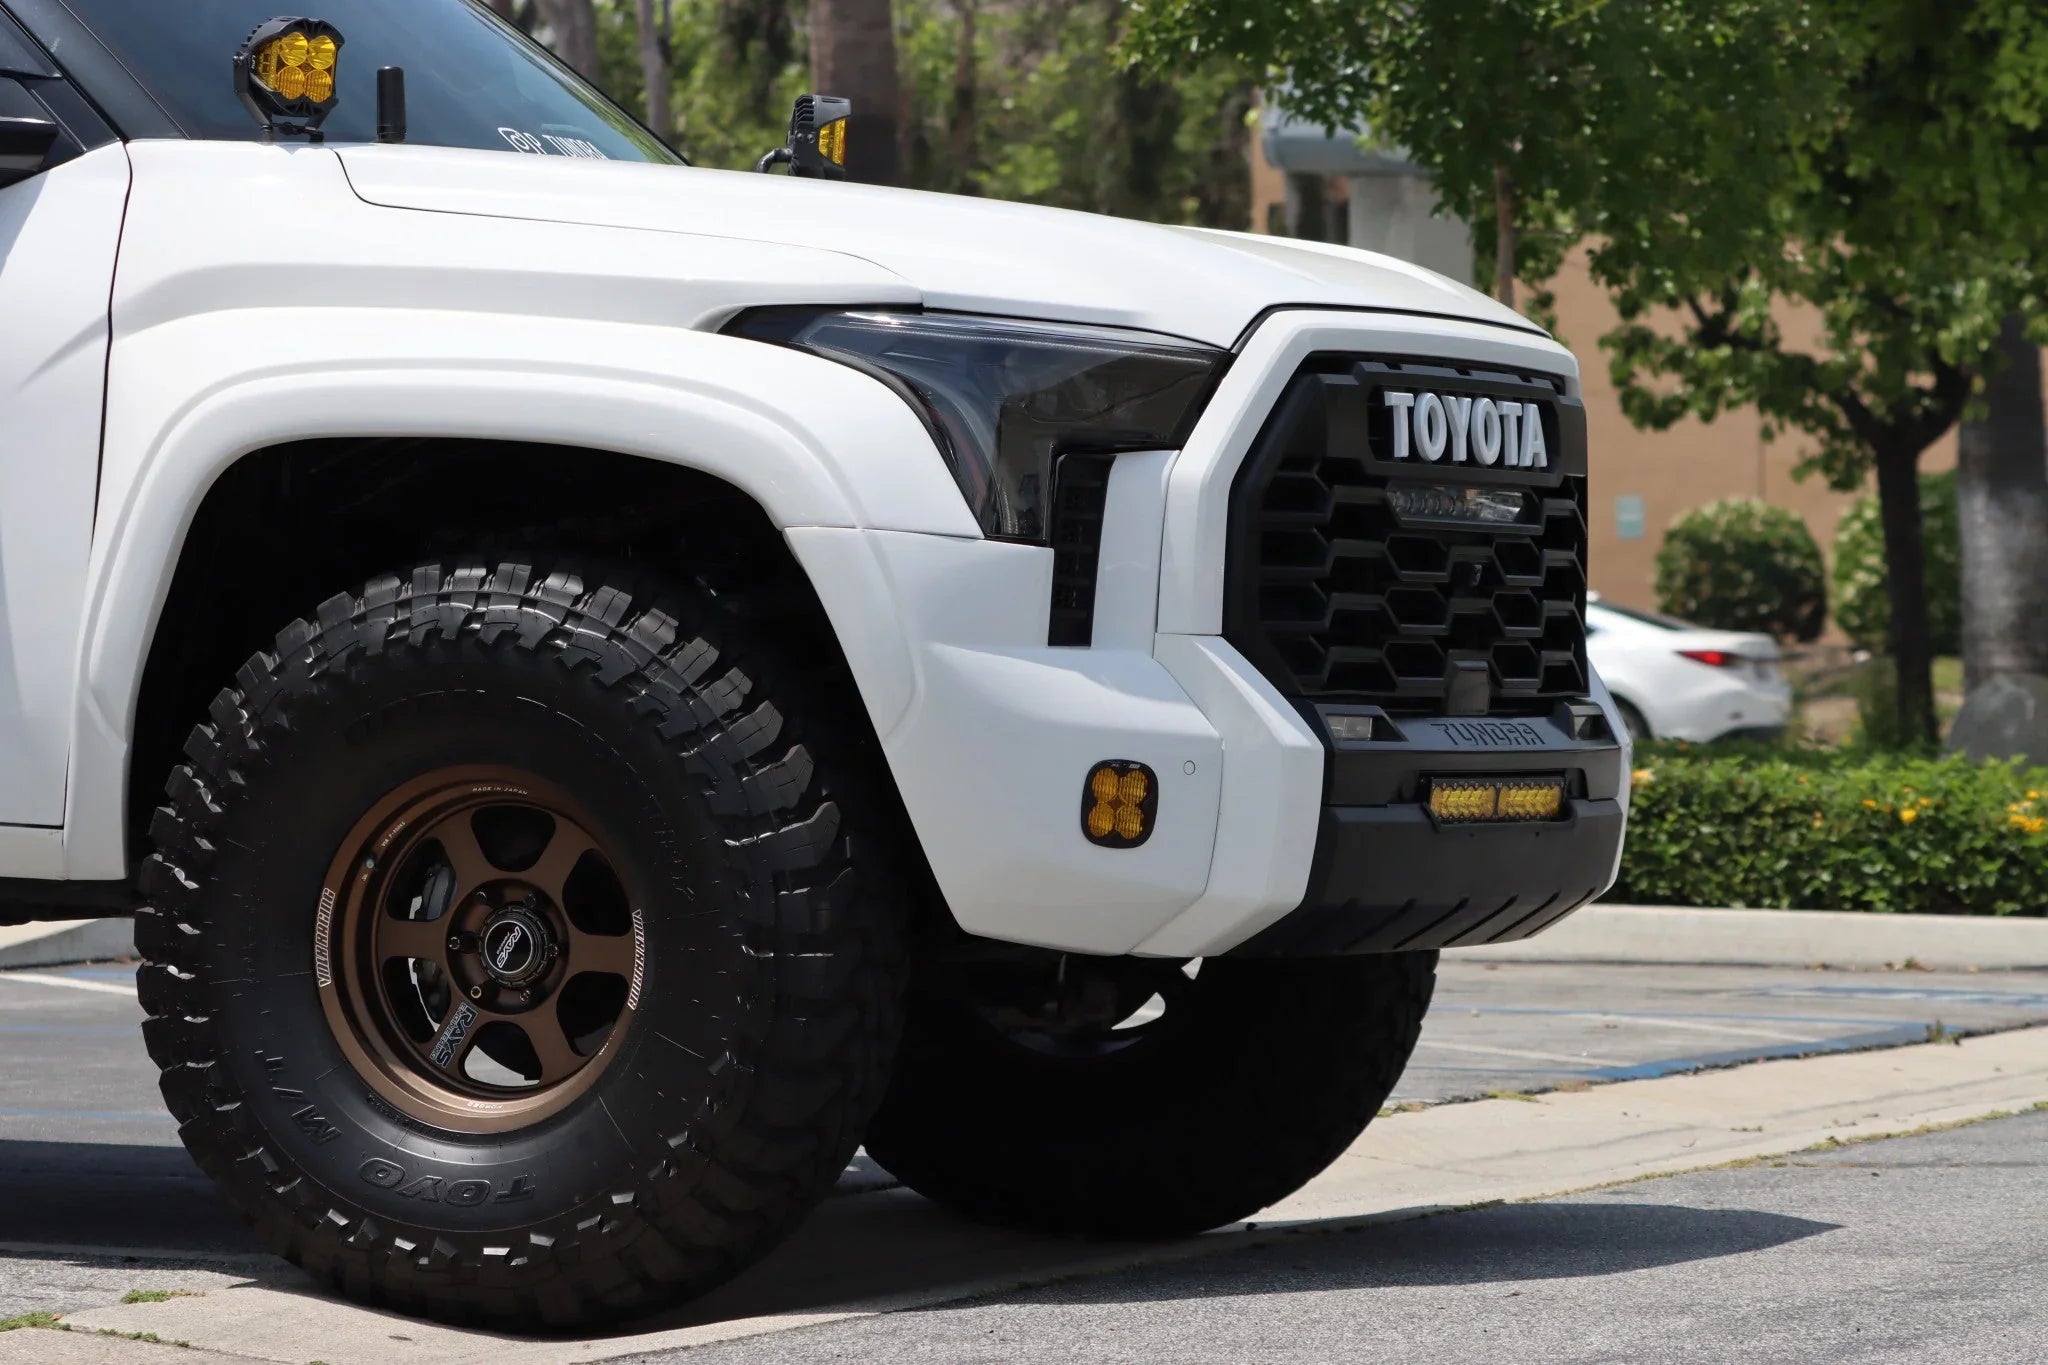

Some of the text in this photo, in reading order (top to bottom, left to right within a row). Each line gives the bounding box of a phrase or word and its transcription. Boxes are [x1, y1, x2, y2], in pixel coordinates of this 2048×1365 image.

[1384, 391, 1548, 468] TOYOTA
[1430, 723, 1546, 746] TUNDRA
[503, 787, 528, 795] JAPAN
[496, 926, 522, 969] RAYS
[429, 1001, 467, 1061] ENGINEERING
[435, 1004, 479, 1069] RAYS
[359, 1157, 536, 1206] TOYO
